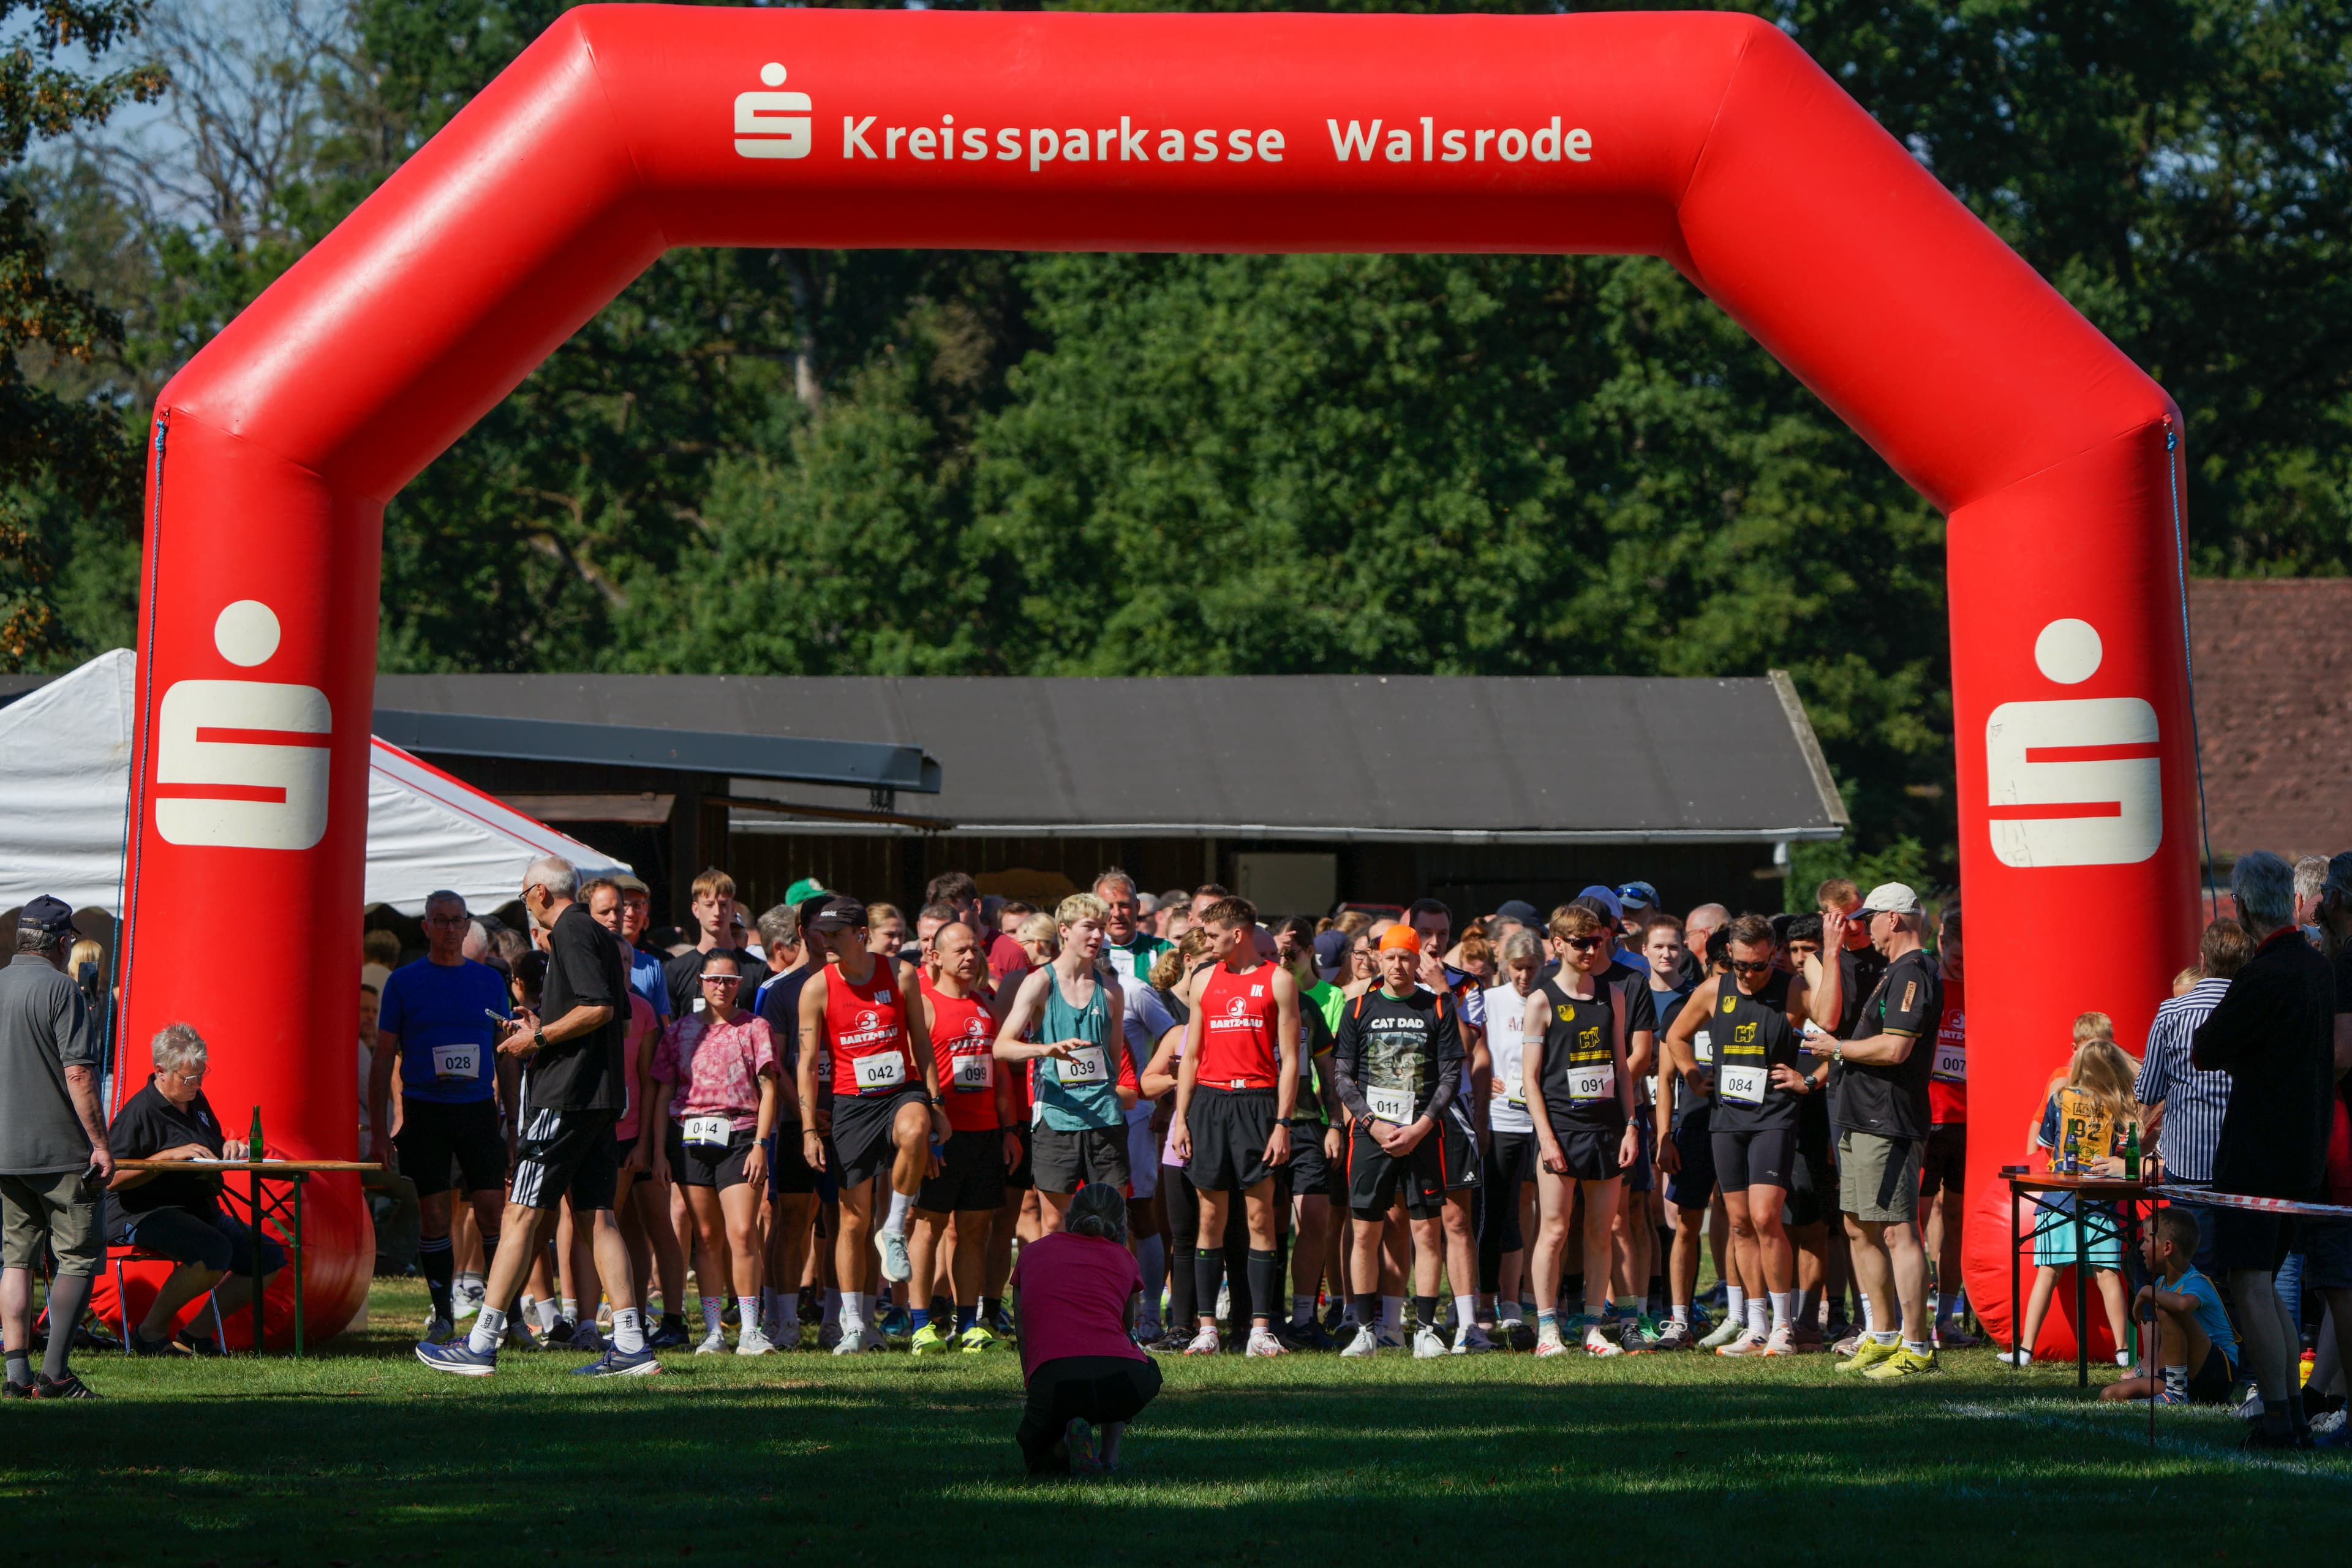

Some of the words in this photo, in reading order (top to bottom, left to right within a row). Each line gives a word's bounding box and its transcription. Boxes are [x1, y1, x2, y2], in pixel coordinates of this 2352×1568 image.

[843, 113, 1286, 172] Kreissparkasse
[1326, 115, 1593, 162] Walsrode
[873, 989, 892, 1006] NH
[1250, 984, 1264, 997] IK
[1371, 1017, 1395, 1029] CAT
[1397, 1017, 1425, 1029] DAD
[445, 1057, 471, 1069] 028
[818, 1063, 831, 1076] 52
[1070, 1060, 1095, 1076] 039
[1943, 1057, 1966, 1072] 007
[868, 1065, 894, 1081] 042
[965, 1067, 987, 1080] 099
[1581, 1077, 1605, 1093] 091
[1728, 1078, 1752, 1093] 084
[1377, 1100, 1400, 1115] 011
[2074, 1118, 2101, 1141] 92
